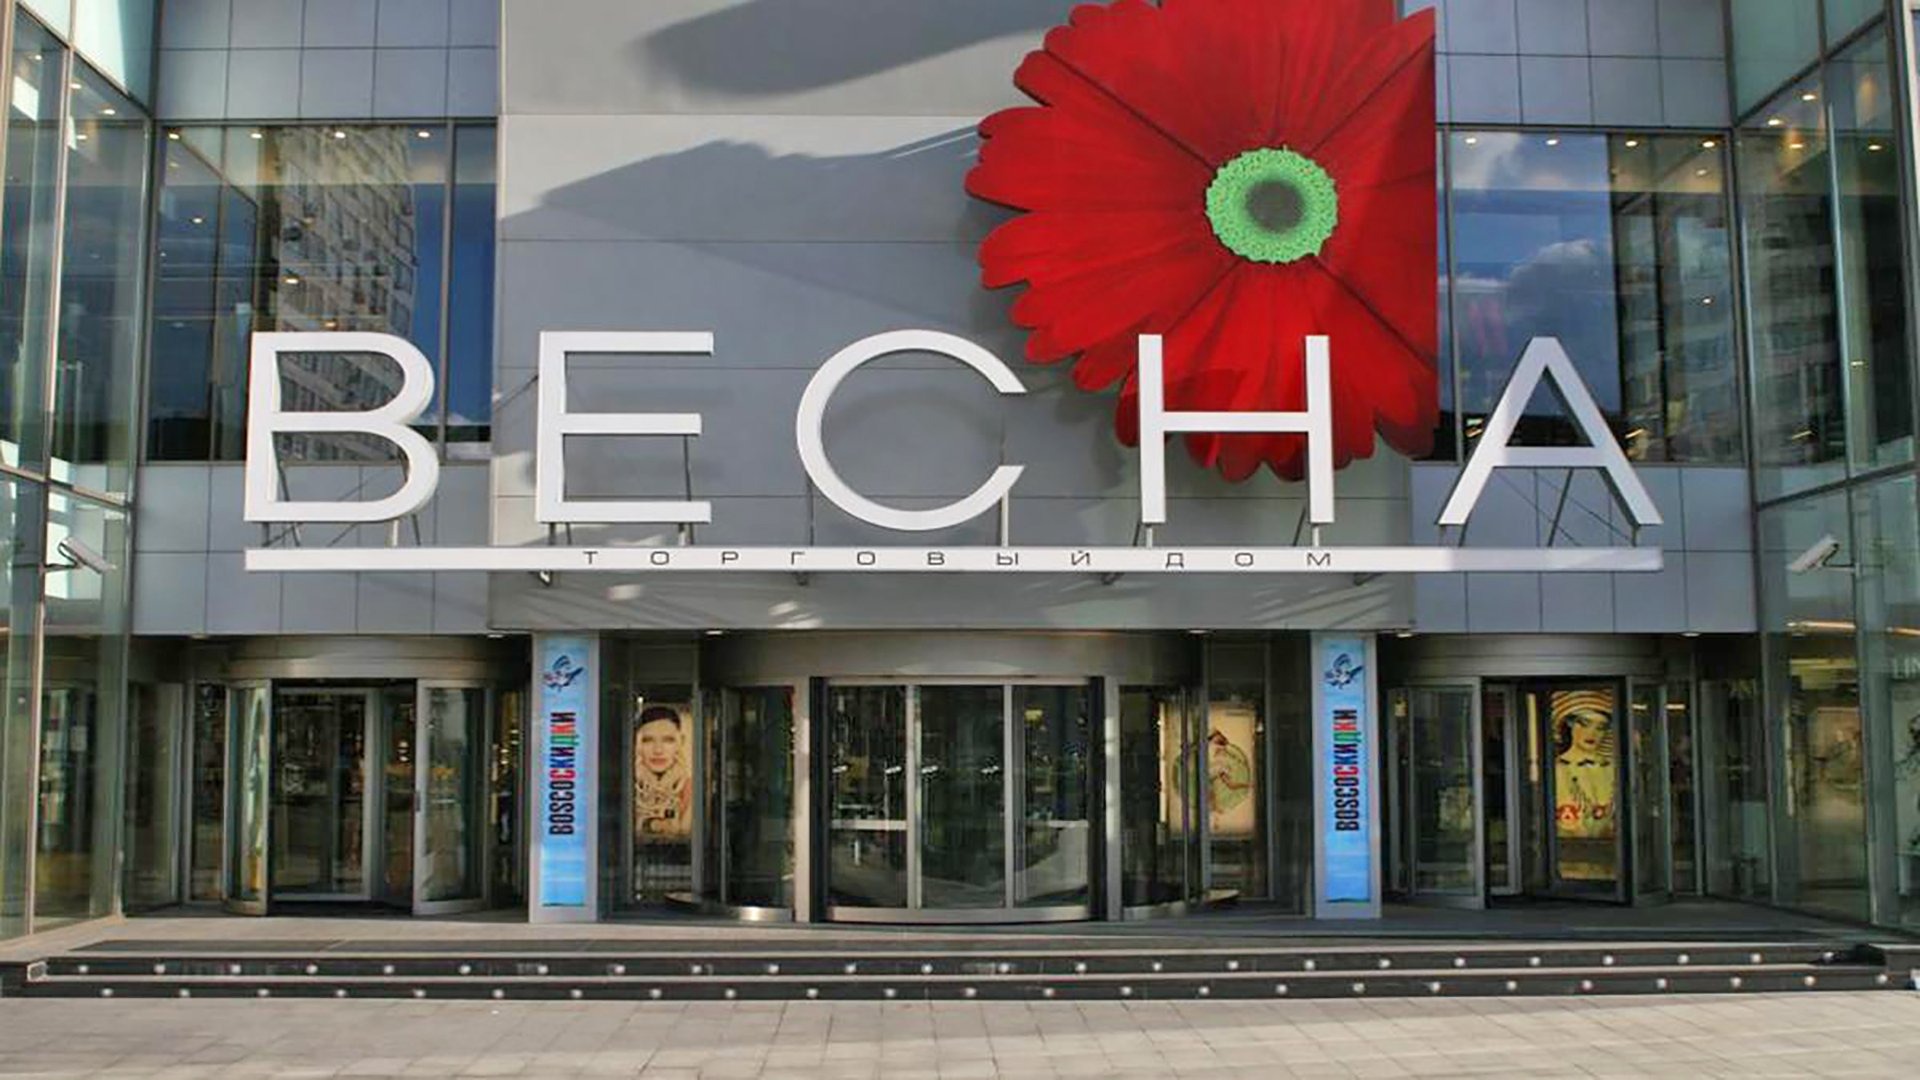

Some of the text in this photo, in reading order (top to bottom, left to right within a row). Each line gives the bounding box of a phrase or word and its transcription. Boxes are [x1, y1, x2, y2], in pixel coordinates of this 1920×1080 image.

[244, 330, 1662, 530] ВЕСНА
[583, 550, 1331, 568] ТОРГОВЫЙ ДОМ
